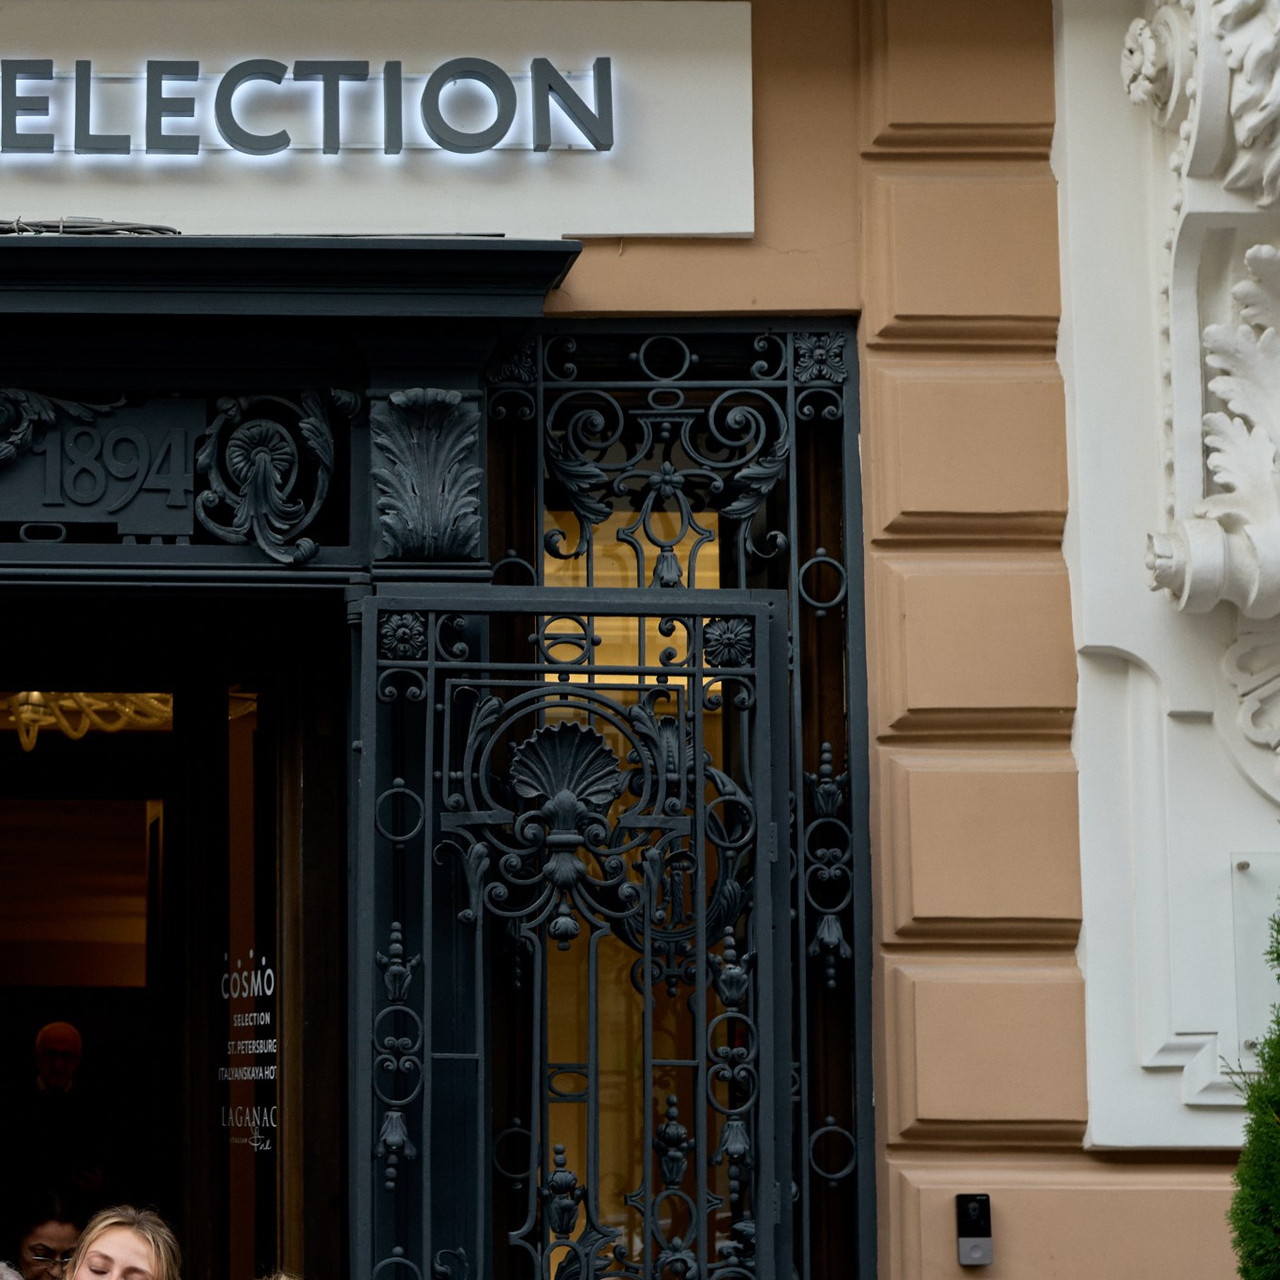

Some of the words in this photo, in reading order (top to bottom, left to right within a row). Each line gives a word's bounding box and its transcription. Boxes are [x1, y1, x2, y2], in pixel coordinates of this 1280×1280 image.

[33, 424, 195, 513] 1894
[221, 968, 275, 1000] COSMO
[234, 1012, 271, 1027] SELECTION
[227, 1041, 237, 1055] ST.
[237, 1039, 278, 1055] PETERSBURG
[218, 1066, 264, 1081] ITALYANSKAYA
